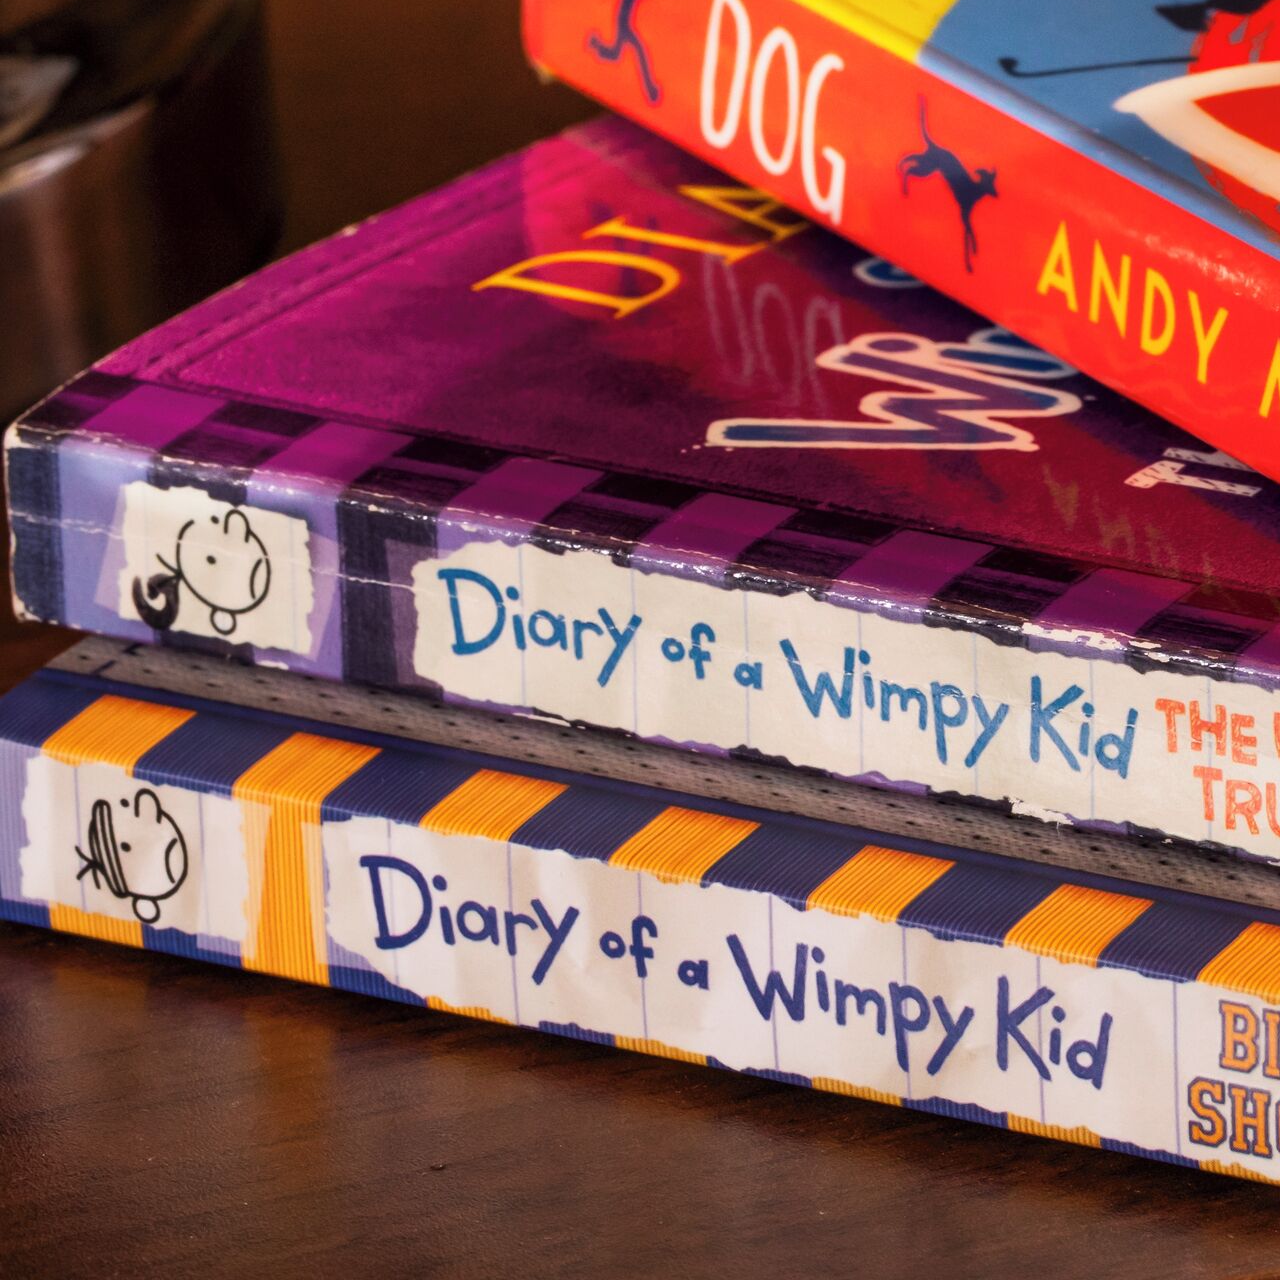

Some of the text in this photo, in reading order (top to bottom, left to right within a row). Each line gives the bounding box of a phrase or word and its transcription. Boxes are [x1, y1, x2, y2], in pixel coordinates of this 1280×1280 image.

[471, 183, 806, 319] DIA
[1037, 220, 1228, 384] ANDY
[437, 567, 1138, 779] Diary of a Wimpy Kid
[1155, 696, 1258, 767] THE
[359, 854, 1113, 1091] Diary of a Wimpy Kid
